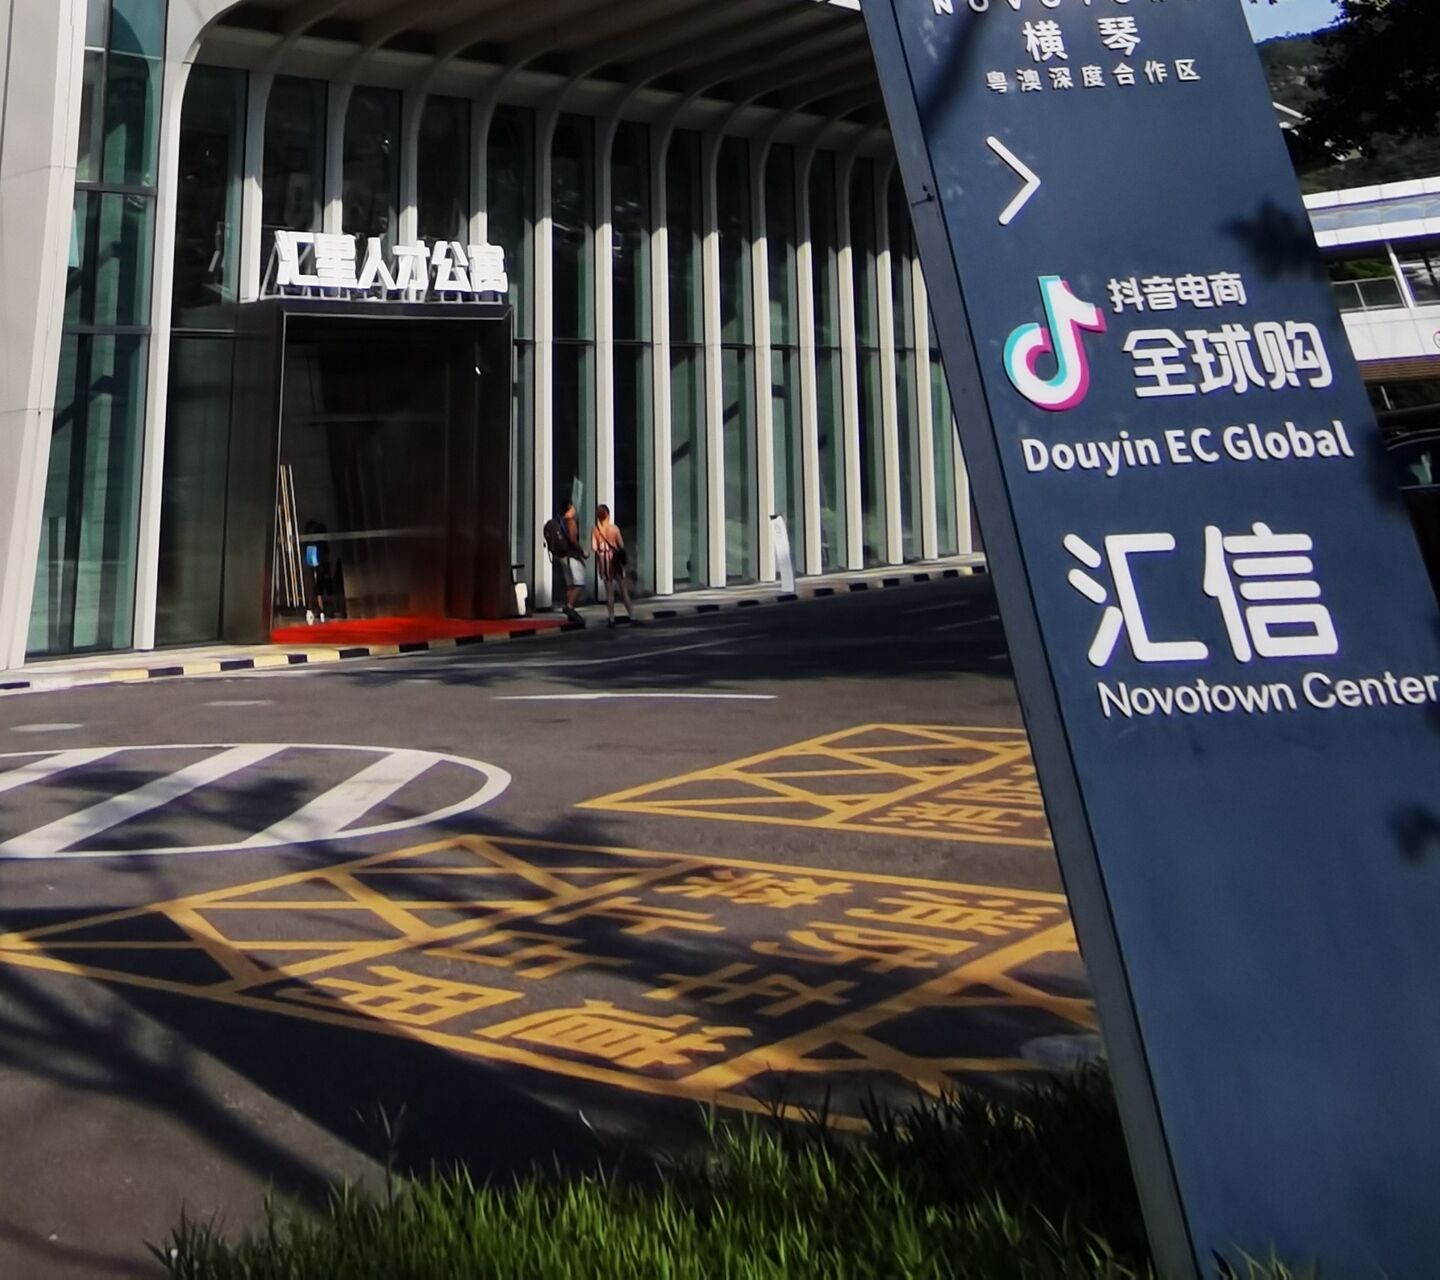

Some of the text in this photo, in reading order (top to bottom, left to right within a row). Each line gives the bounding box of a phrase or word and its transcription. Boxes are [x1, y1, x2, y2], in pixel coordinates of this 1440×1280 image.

[1021, 15, 1142, 63] 横琴
[985, 57, 1202, 94] 粤澳深度合作区
[1106, 270, 1248, 313] 抖音电商
[1122, 320, 1334, 397] 全球购
[1021, 420, 1356, 478] Douyin EC Global
[1063, 521, 1340, 667] 汇信
[1097, 670, 1439, 717] Novotown Center
